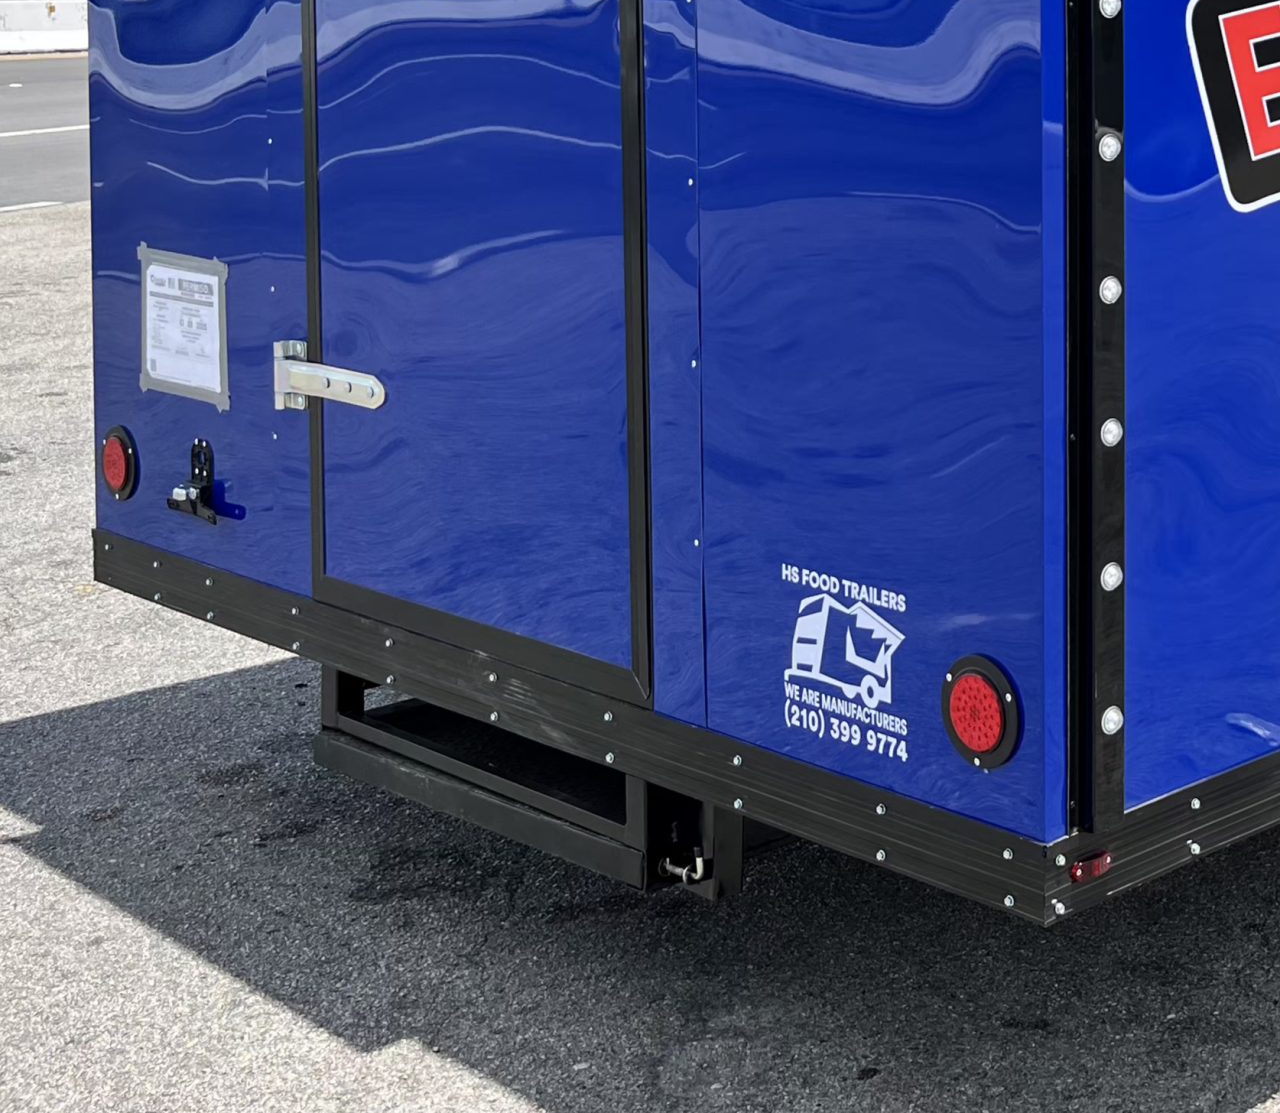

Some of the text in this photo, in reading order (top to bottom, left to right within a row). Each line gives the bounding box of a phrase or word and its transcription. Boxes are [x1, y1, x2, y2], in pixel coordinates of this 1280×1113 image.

[782, 563, 906, 612] HS FOOD TRAILERS
[784, 681, 907, 736] WE ARE MANUFACTURERS
[785, 699, 908, 762] (210) 399 9774
